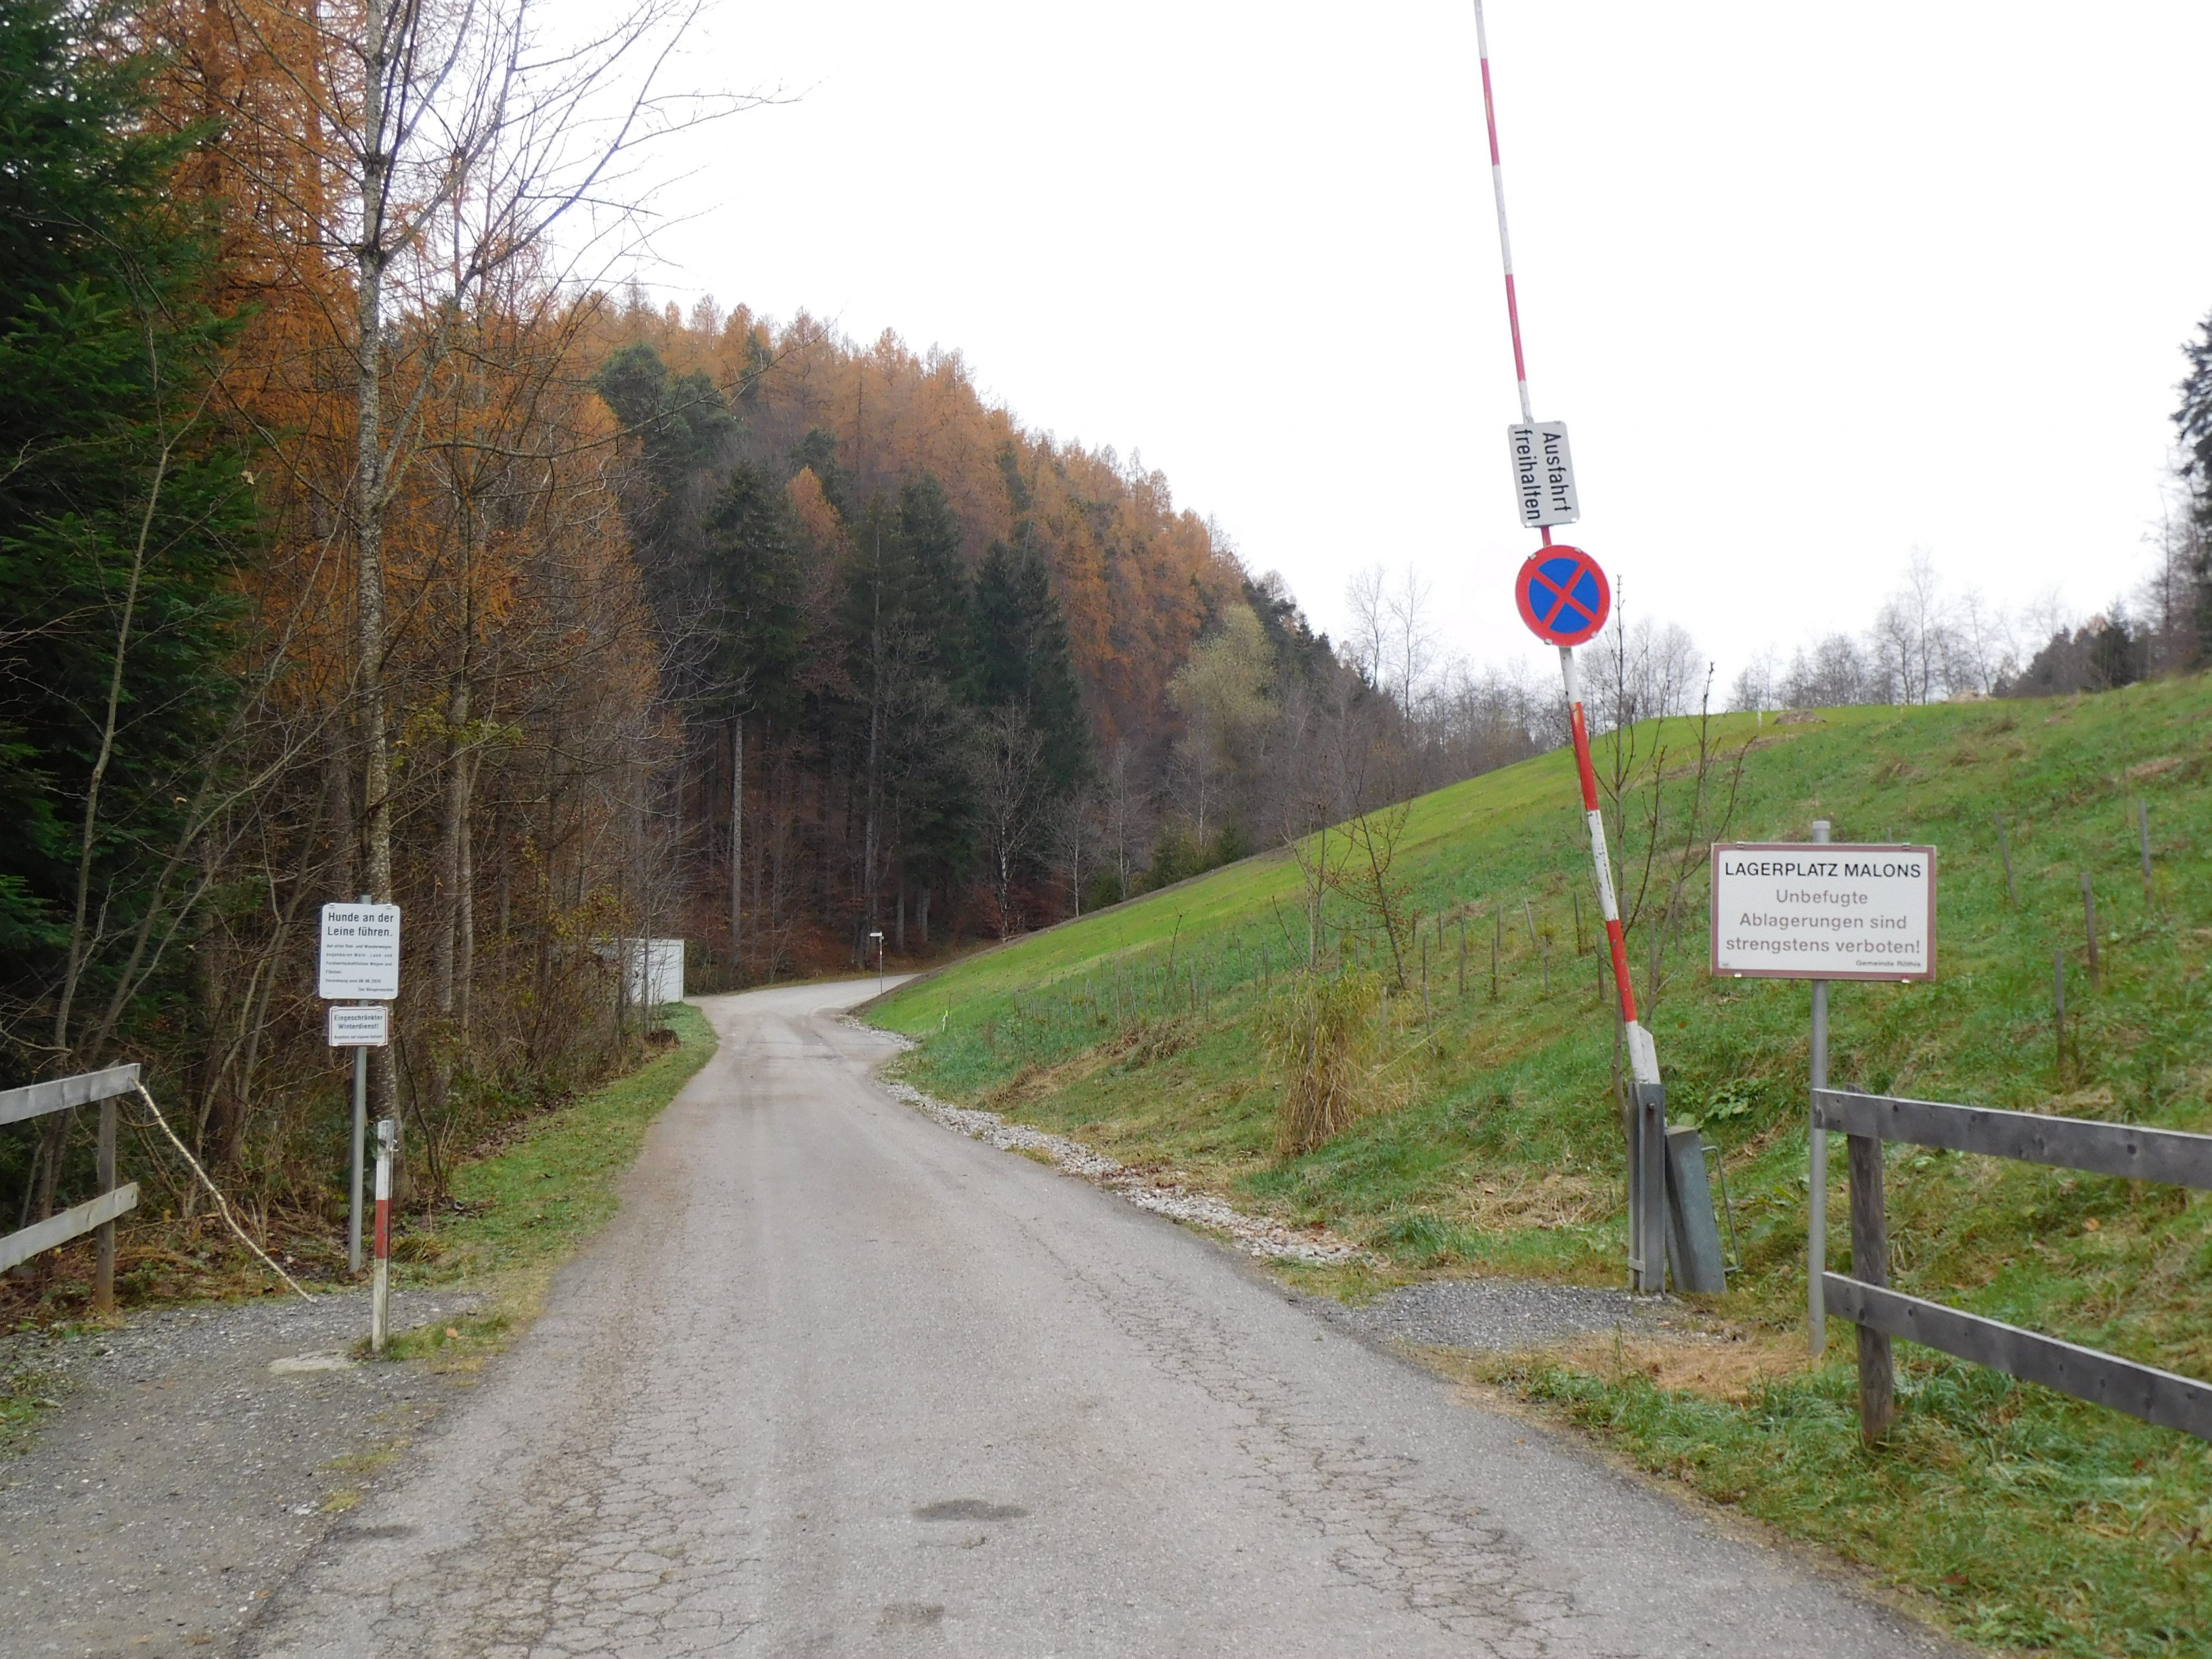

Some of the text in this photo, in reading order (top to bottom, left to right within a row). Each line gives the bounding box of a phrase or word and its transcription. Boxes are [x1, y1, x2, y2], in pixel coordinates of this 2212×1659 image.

[1514, 429, 1542, 520] freihalten
[1542, 432, 1572, 511] Ausfahrt
[1725, 862, 1921, 878] LAGERPLATZ MALONS
[1776, 889, 1868, 907] Unbefugte
[328, 912, 394, 922] Hunde an der
[1739, 913, 1907, 931] Ablagerungen sind
[328, 926, 393, 936] Leine führen.
[1727, 938, 1920, 954] strengstens verboten!
